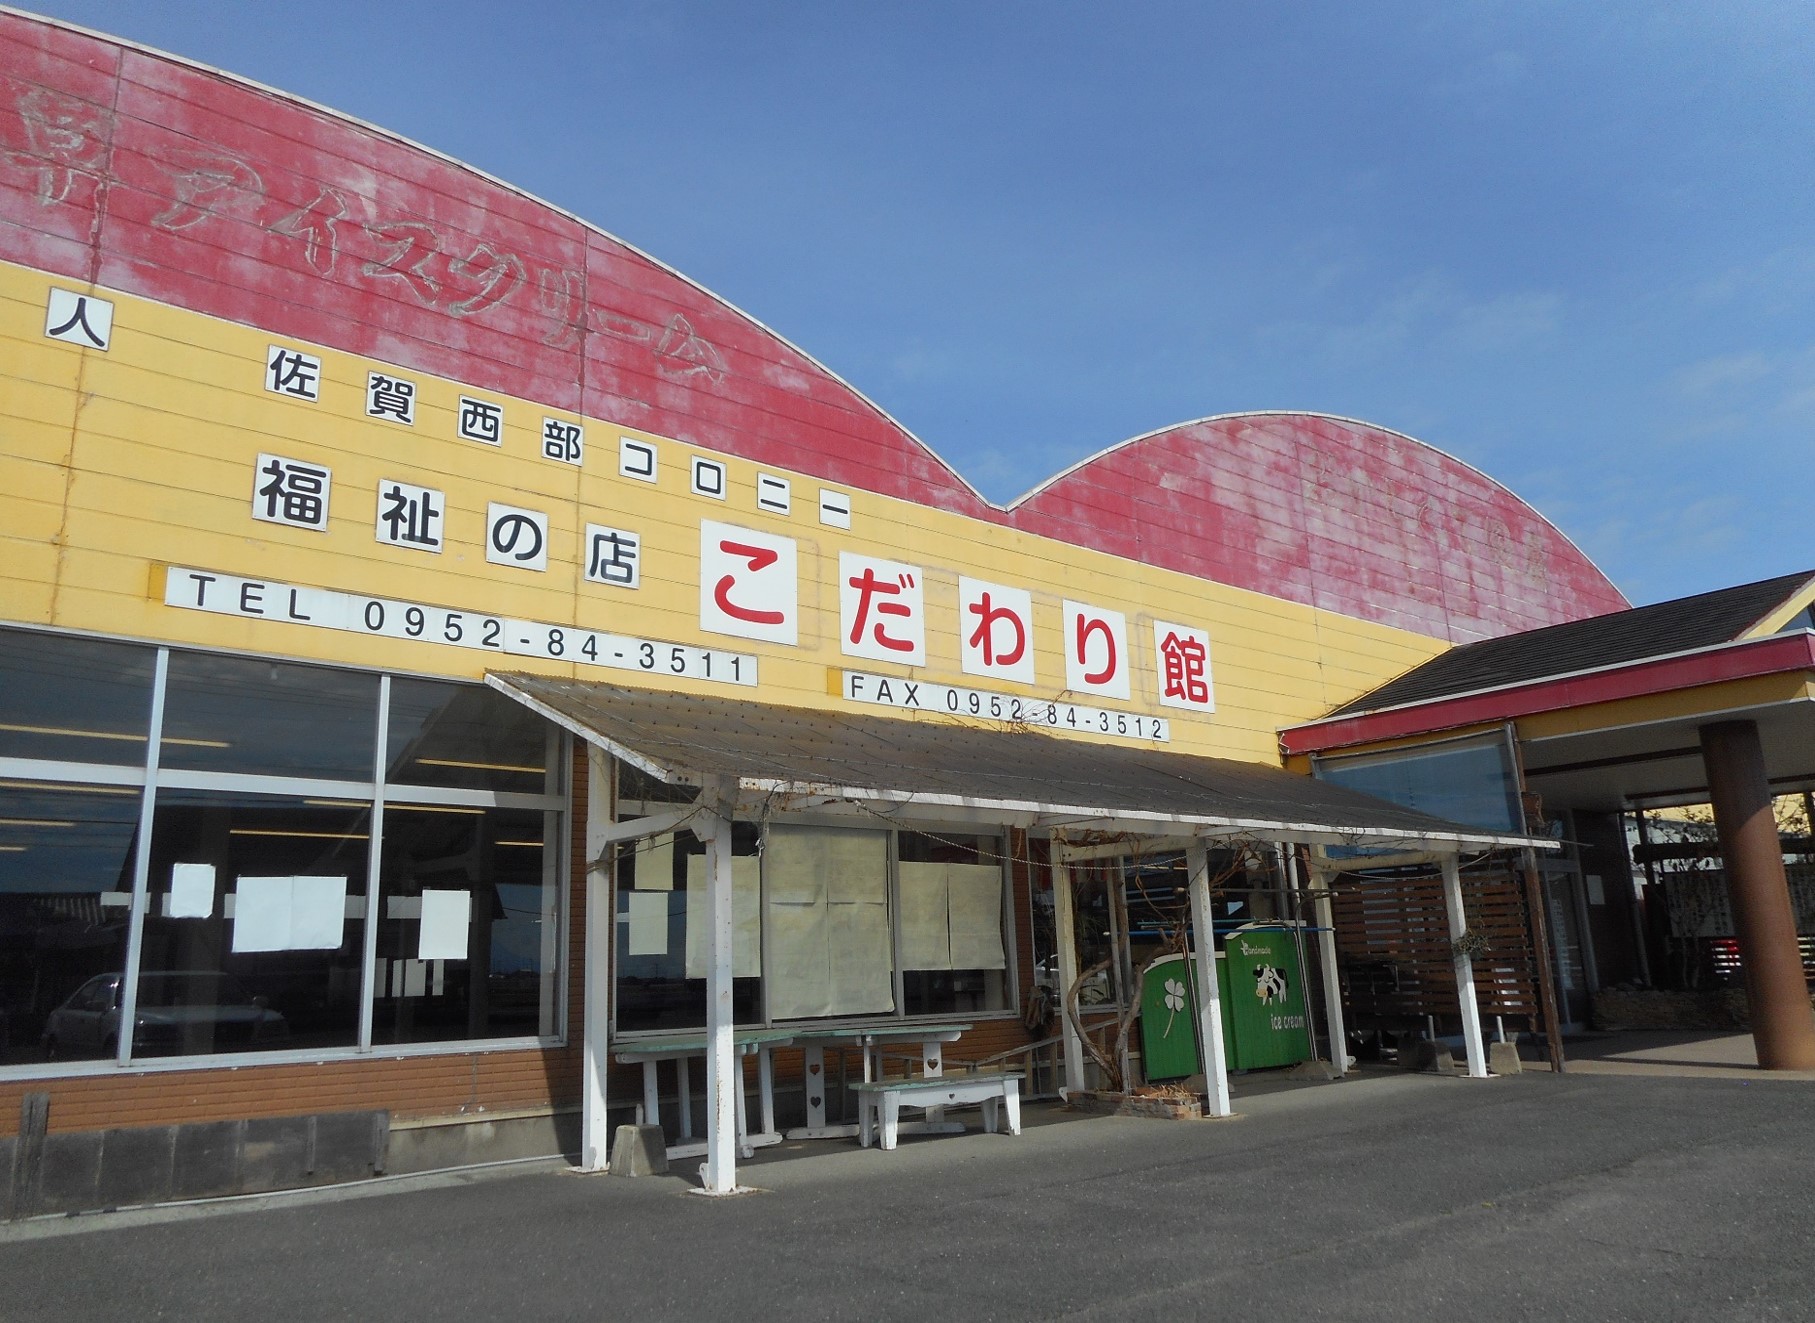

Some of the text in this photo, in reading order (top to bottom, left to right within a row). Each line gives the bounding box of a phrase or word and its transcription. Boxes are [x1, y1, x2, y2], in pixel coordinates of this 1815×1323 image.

[48, 297, 850, 516] 人 佐賀西部コロニー
[188, 573, 742, 683] TEL 0952-84-3511
[259, 458, 1211, 705] 福祉の店 こだわり館
[850, 675, 1163, 740] FAX 0952-84-3512
[1270, 1013, 1305, 1030] ice cream
